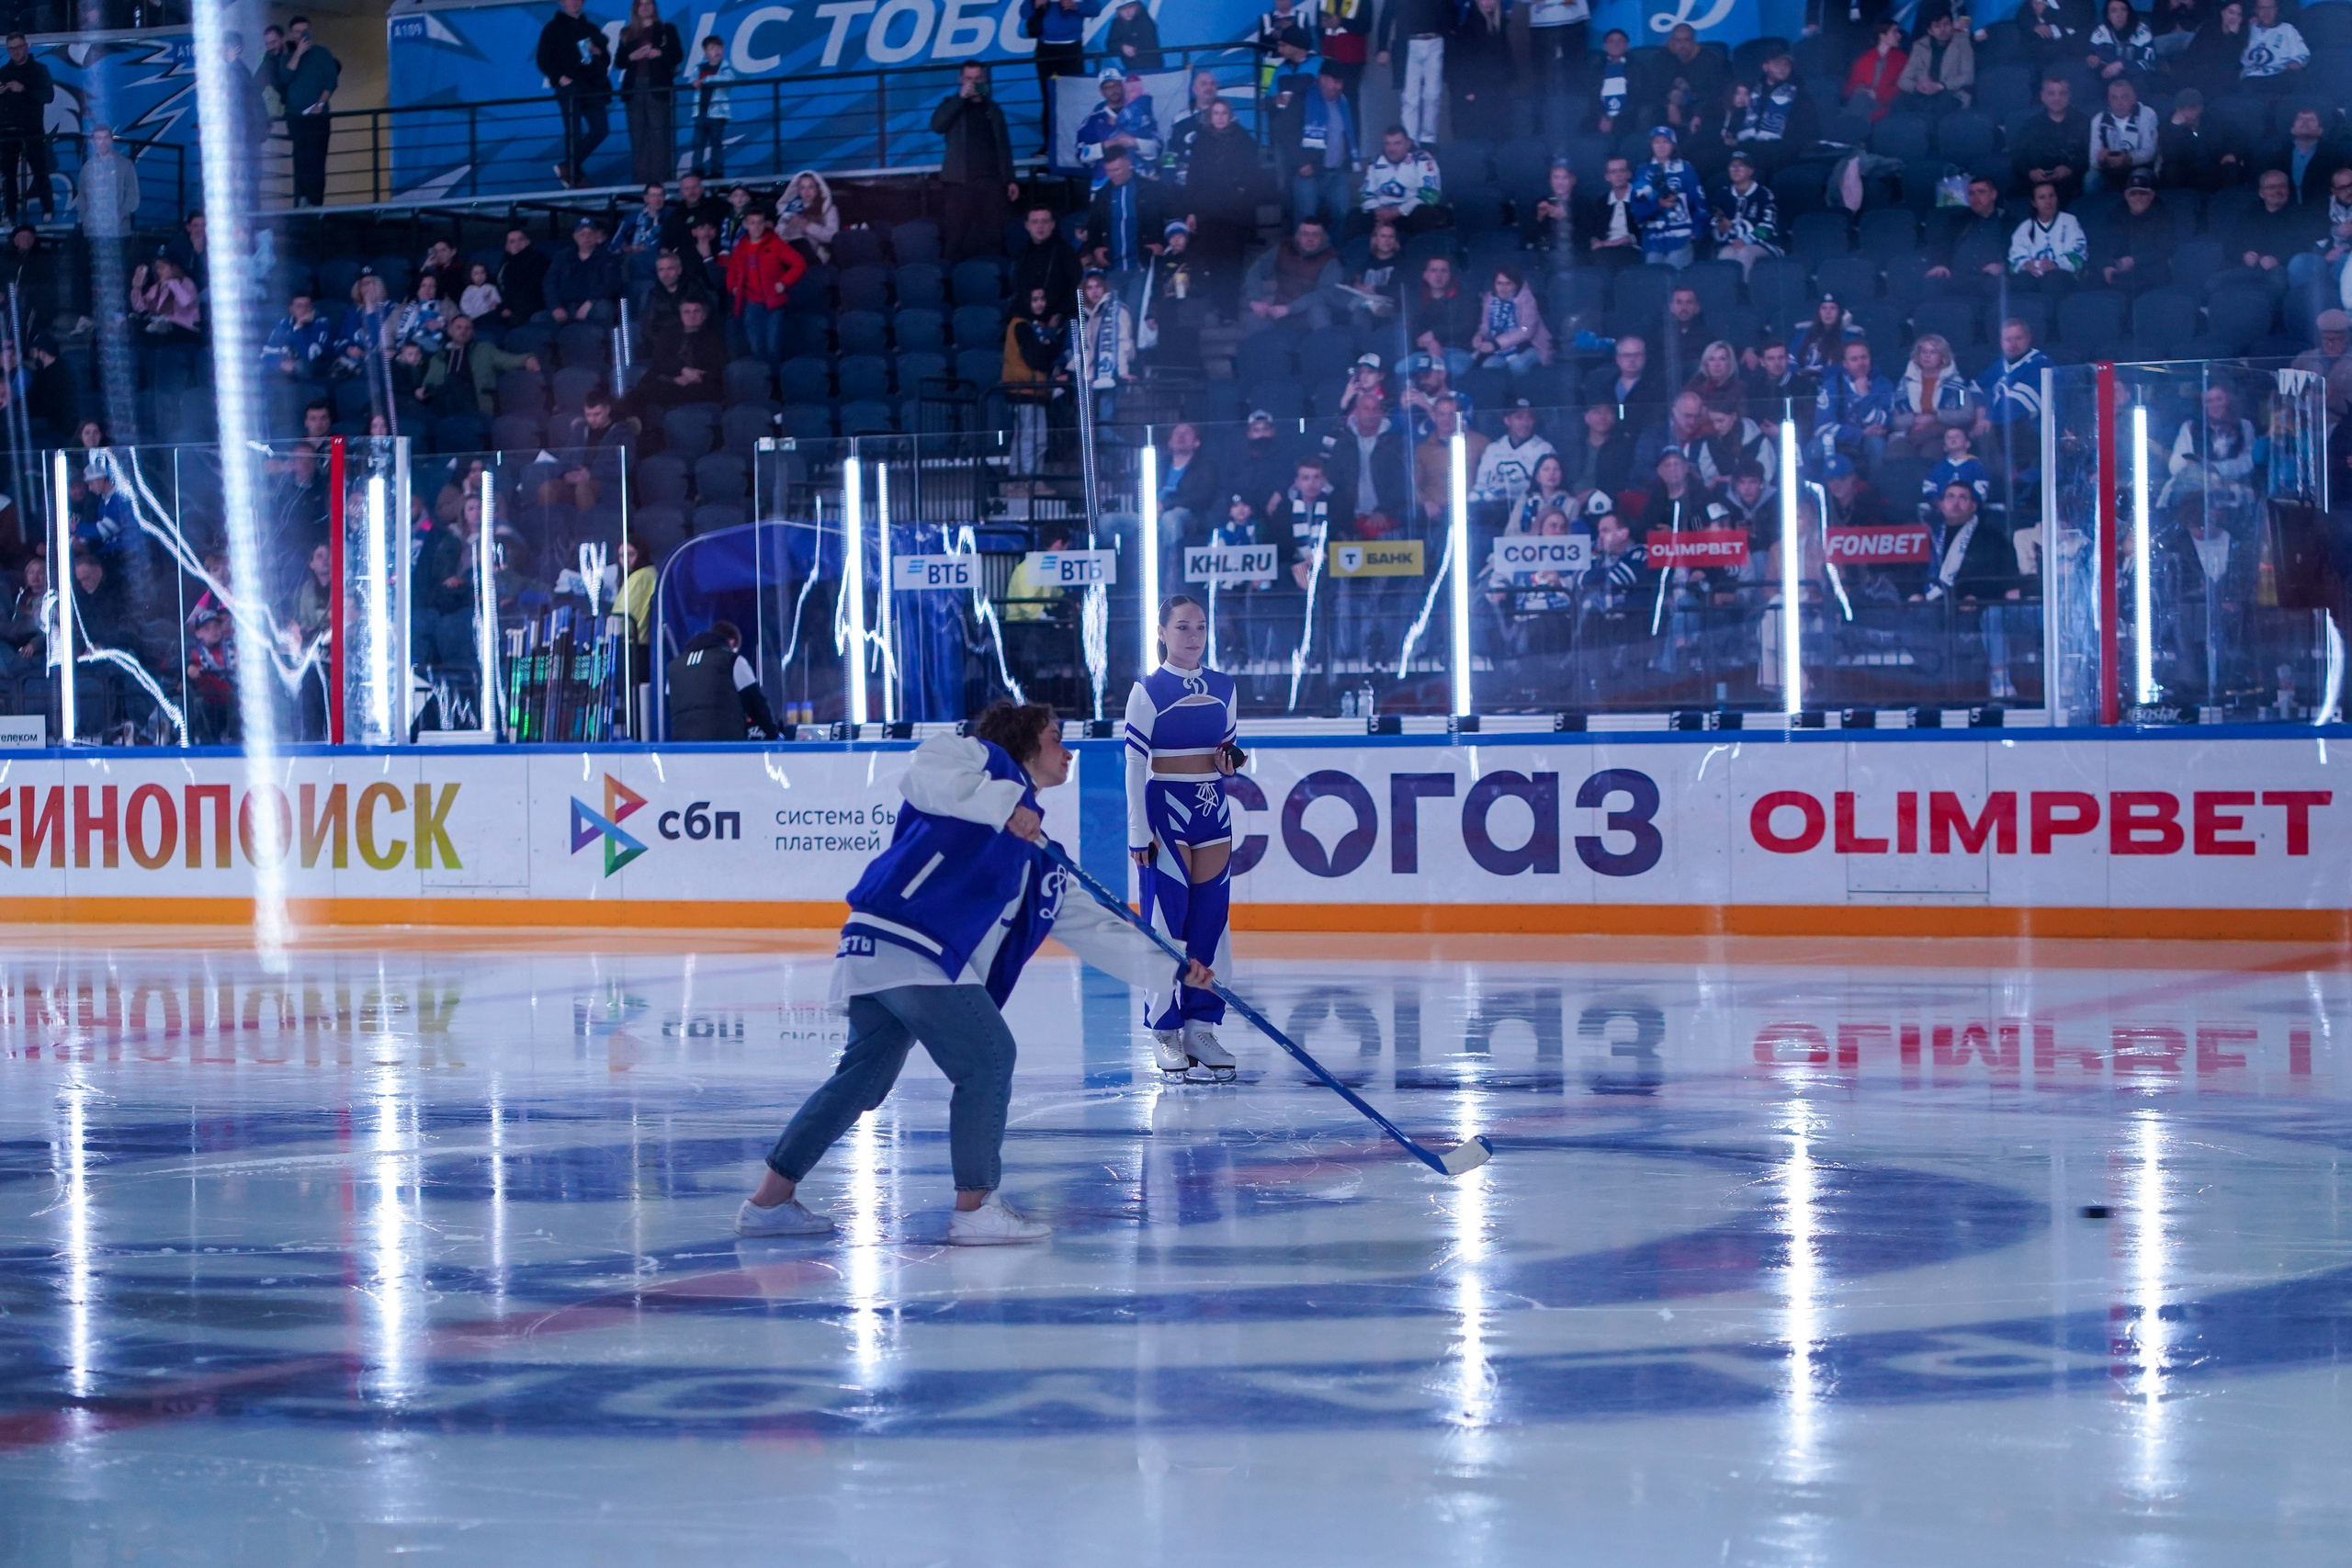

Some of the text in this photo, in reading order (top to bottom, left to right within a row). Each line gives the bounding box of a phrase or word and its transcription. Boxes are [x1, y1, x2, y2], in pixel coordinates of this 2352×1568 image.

[1651, 541, 1744, 558] OLIMPBET
[1827, 533, 1927, 556] FONBET
[1061, 558, 1102, 581] ВТБ
[1190, 552, 1272, 574] KHL.RU
[1367, 552, 1414, 566] БАНК
[928, 563, 968, 584] ВТБ
[0, 782, 464, 871] ИНОПОИСК
[775, 809, 865, 826] система
[1750, 790, 2333, 856] OLIMPBET
[775, 830, 881, 851] платежей
